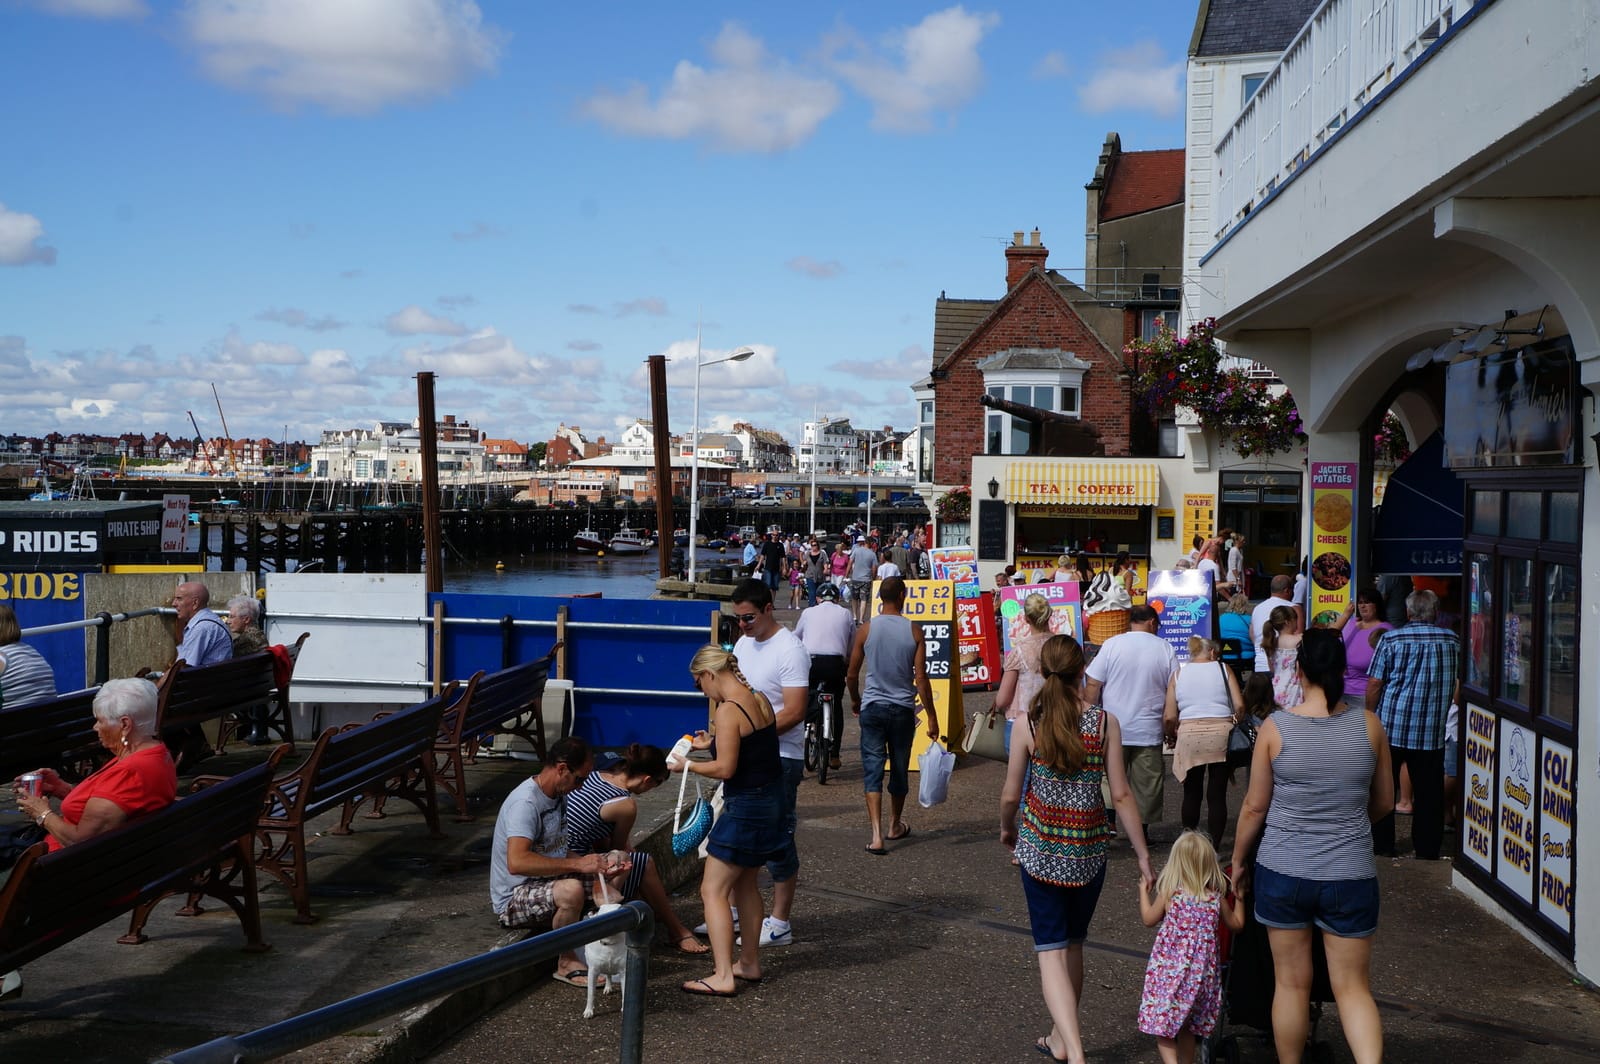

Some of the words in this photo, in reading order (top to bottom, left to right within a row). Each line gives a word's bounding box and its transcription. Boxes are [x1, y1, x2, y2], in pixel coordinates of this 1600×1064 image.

[1313, 474, 1351, 483] POTATOES
[1318, 466, 1347, 475] JACKET
[1030, 484, 1060, 494] TEA
[1078, 484, 1135, 495] COFFEE
[1187, 499, 1211, 507] CAFE
[107, 521, 139, 538] PIRATE
[140, 520, 160, 536] SHIP
[13, 531, 98, 552] RIDES
[1317, 535, 1347, 544] CHEESE
[1021, 560, 1053, 569] MILK
[933, 586, 950, 598] £2
[1015, 586, 1064, 600] WAFFLES
[1318, 594, 1343, 603] CHILLI
[931, 602, 946, 614] £1
[958, 604, 977, 612] Dogs
[962, 615, 981, 636] £1
[959, 644, 980, 654] rgers
[961, 665, 989, 683] .50
[1469, 710, 1494, 741] CURRY
[1466, 738, 1494, 771] GRAVY
[1544, 750, 1571, 792] COL
[1471, 773, 1489, 800] Real
[1504, 775, 1532, 810] Quality
[1465, 799, 1494, 832] MUSHY
[1501, 806, 1523, 838] FISH
[1525, 820, 1533, 845] &
[1468, 826, 1489, 857] PEAS
[1503, 837, 1531, 873] CHIPS
